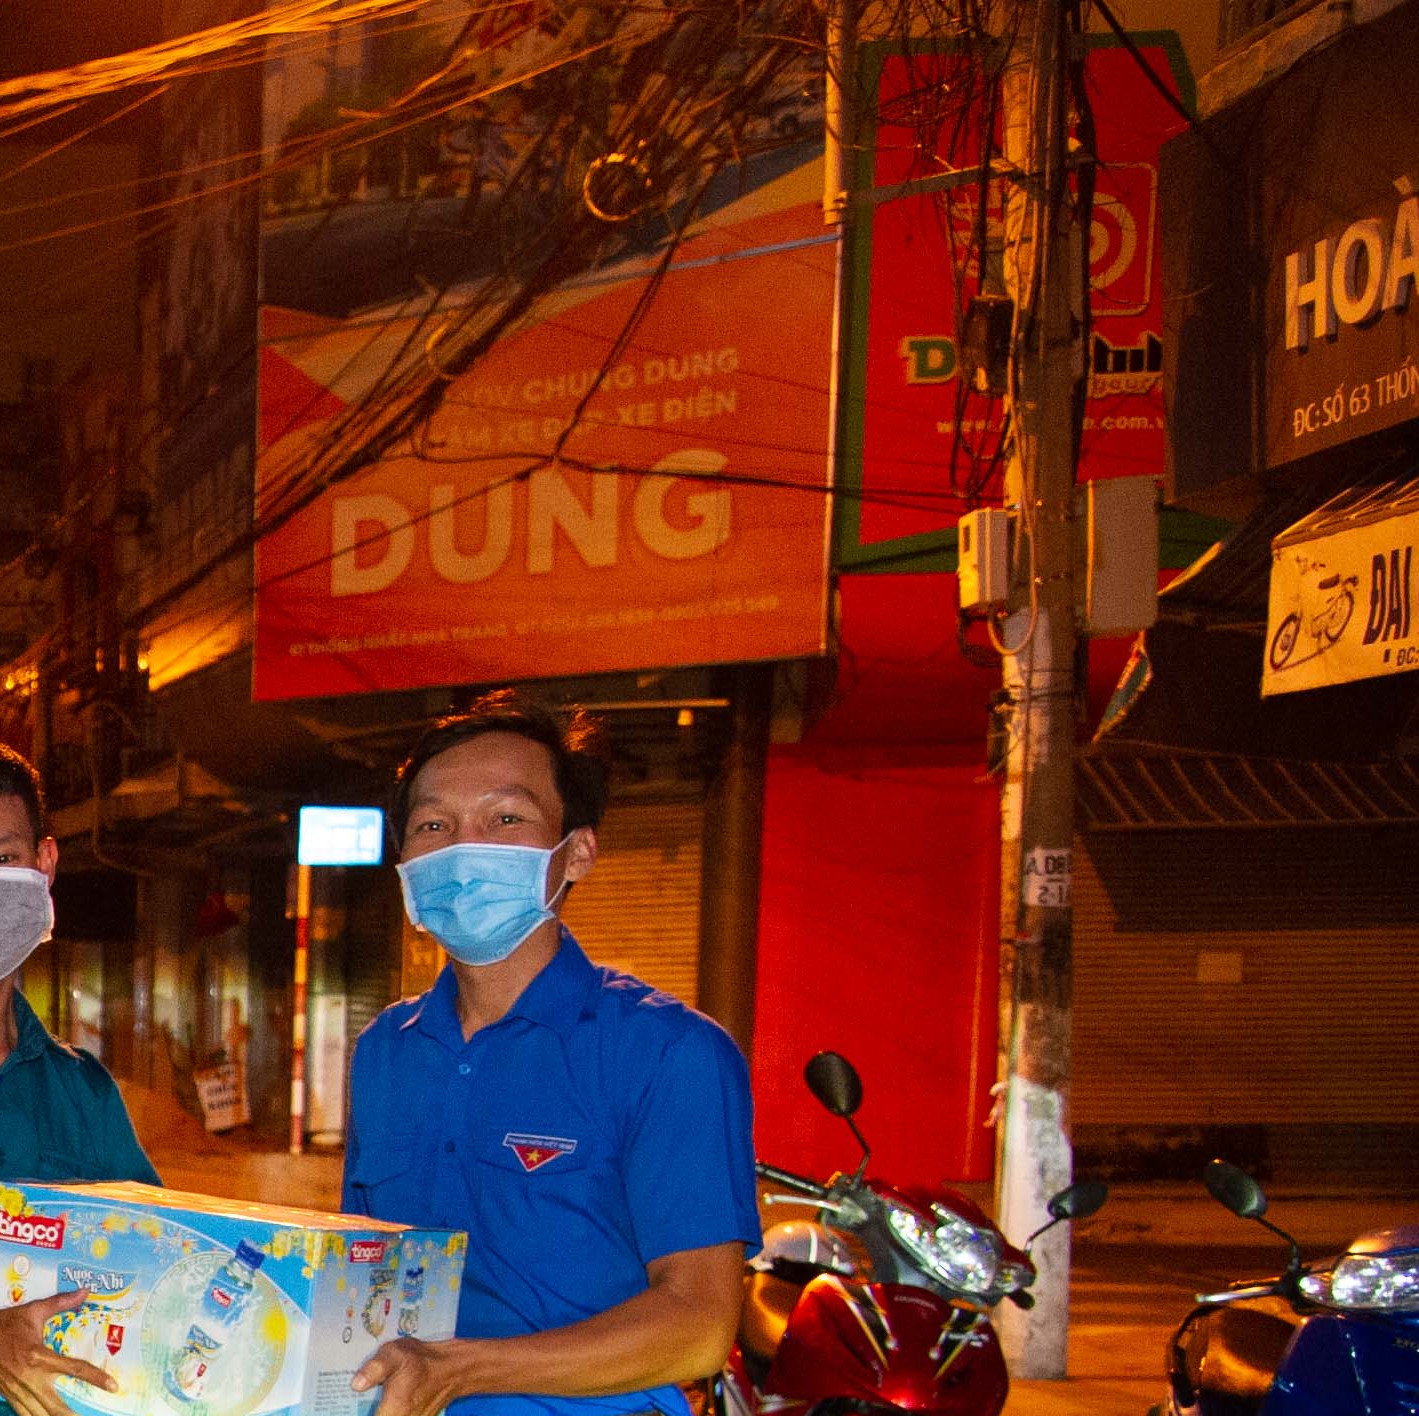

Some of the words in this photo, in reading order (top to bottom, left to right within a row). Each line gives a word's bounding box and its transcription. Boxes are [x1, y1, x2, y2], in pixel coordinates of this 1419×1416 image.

[643, 347, 739, 386] DUNG
[1349, 384, 1371, 419] 63
[329, 448, 734, 598] DUNG
